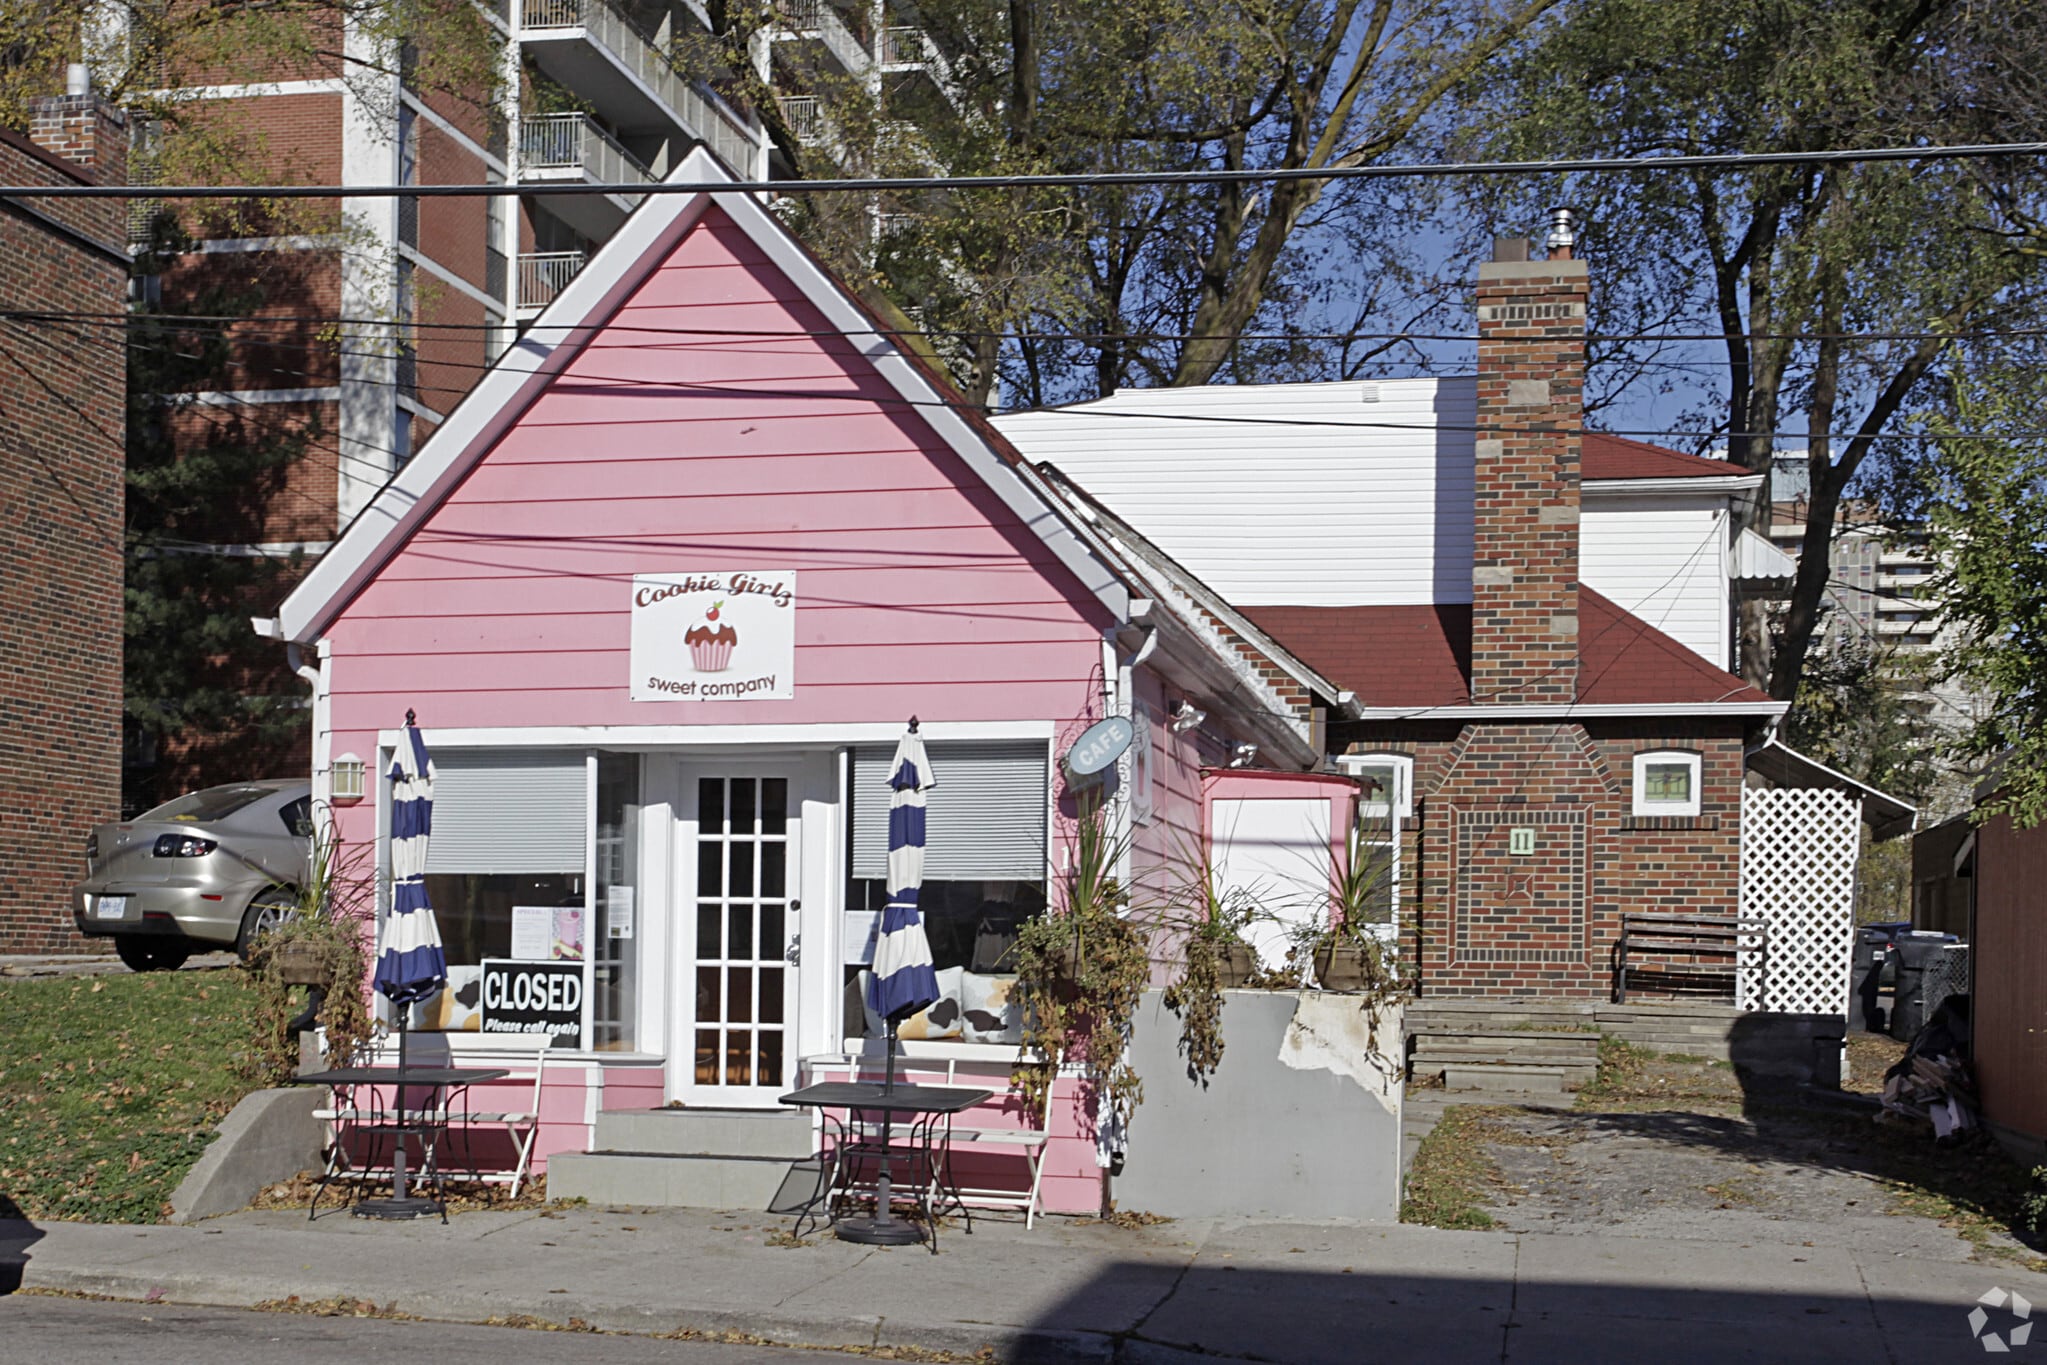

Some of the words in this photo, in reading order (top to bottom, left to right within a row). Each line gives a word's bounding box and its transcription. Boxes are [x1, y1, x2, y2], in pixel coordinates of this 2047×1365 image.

[635, 575, 722, 607] Cookie
[727, 573, 793, 608] Girlz
[648, 676, 697, 695] sweet
[700, 674, 776, 698] company
[1079, 725, 1124, 767] CAFE
[1514, 832, 1529, 850] 11
[484, 971, 582, 1012] CLOSED
[484, 1018, 522, 1034] Please
[522, 1020, 547, 1034] call
[546, 1021, 580, 1038] again
